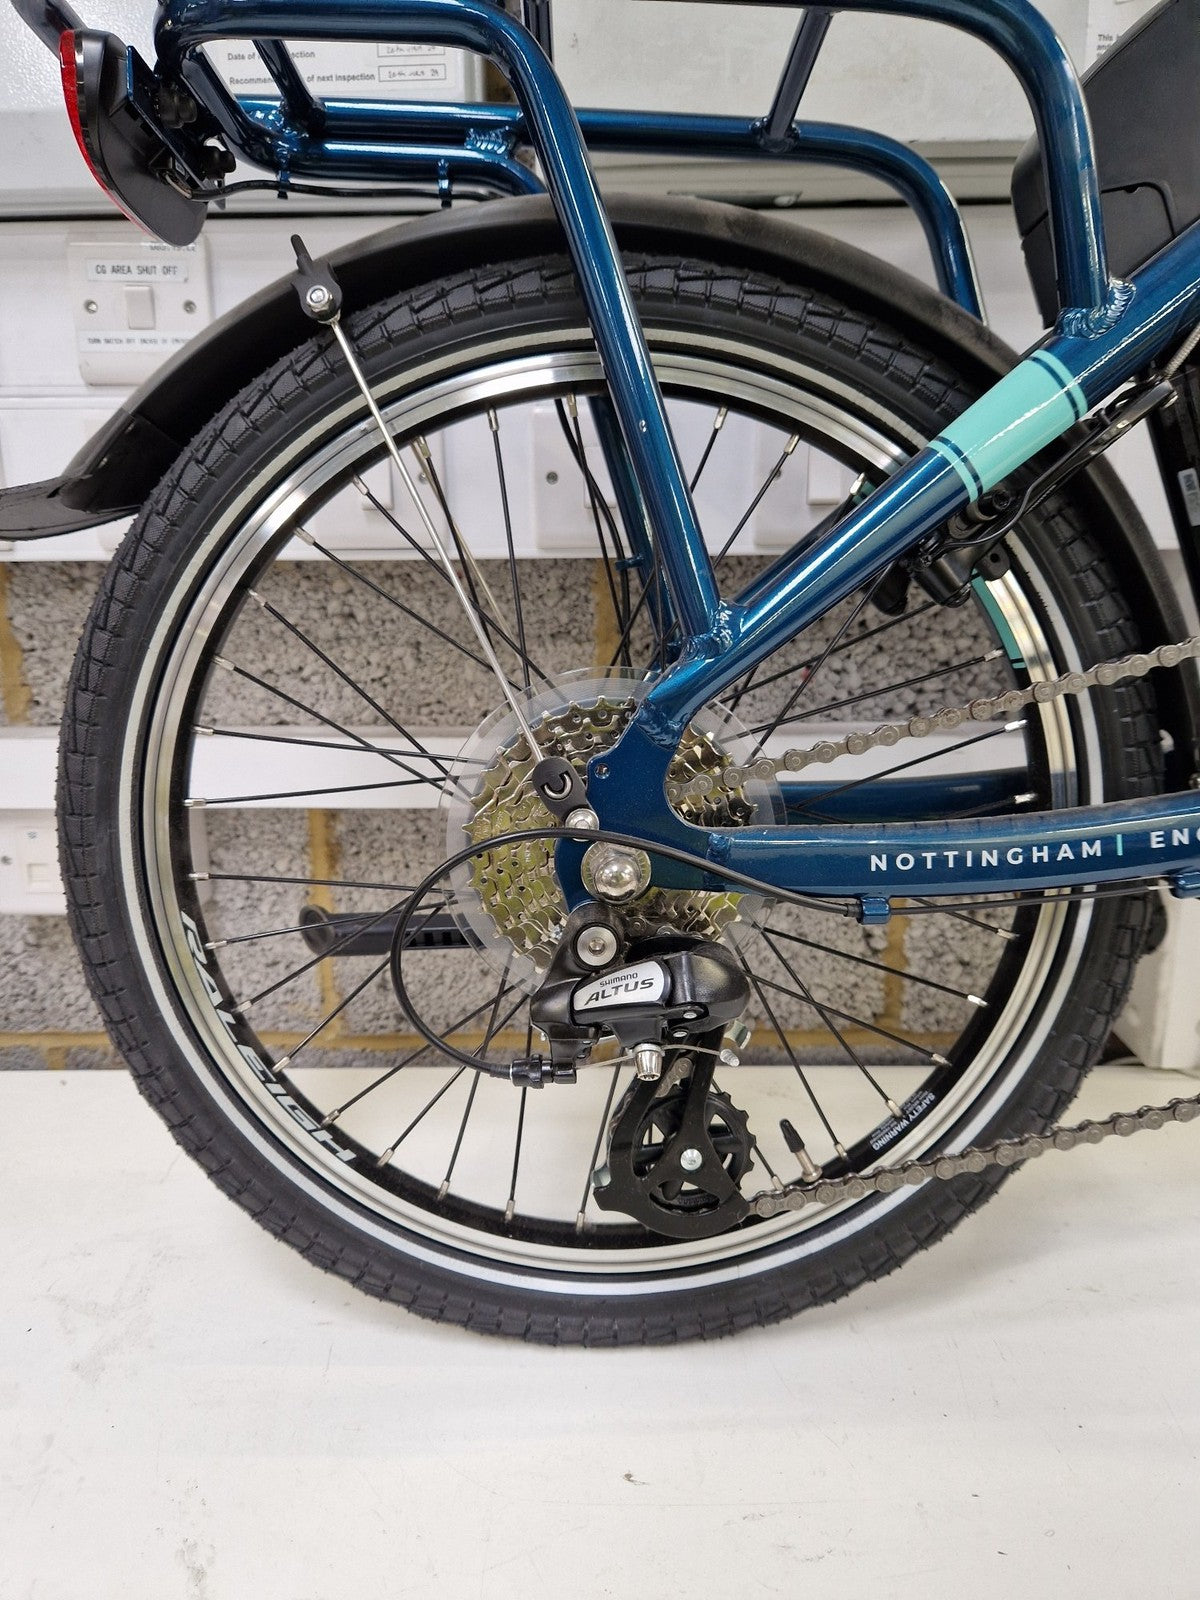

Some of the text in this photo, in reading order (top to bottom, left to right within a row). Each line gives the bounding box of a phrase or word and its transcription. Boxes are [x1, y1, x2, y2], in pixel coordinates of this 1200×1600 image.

[247, 52, 255, 60] of
[229, 77, 273, 85] Recommen
[317, 74, 333, 82] next
[335, 72, 375, 83] inspection
[95, 264, 178, 275] CG AREA SHUT OFF
[870, 827, 1200, 872] NOTTINGHAM EN
[600, 972, 638, 987] SHIMANO
[584, 978, 654, 1006] ALTUS
[181, 910, 357, 1162] RALEIGH
[908, 1092, 936, 1122] SAFETY
[872, 1119, 910, 1151] WARNING
